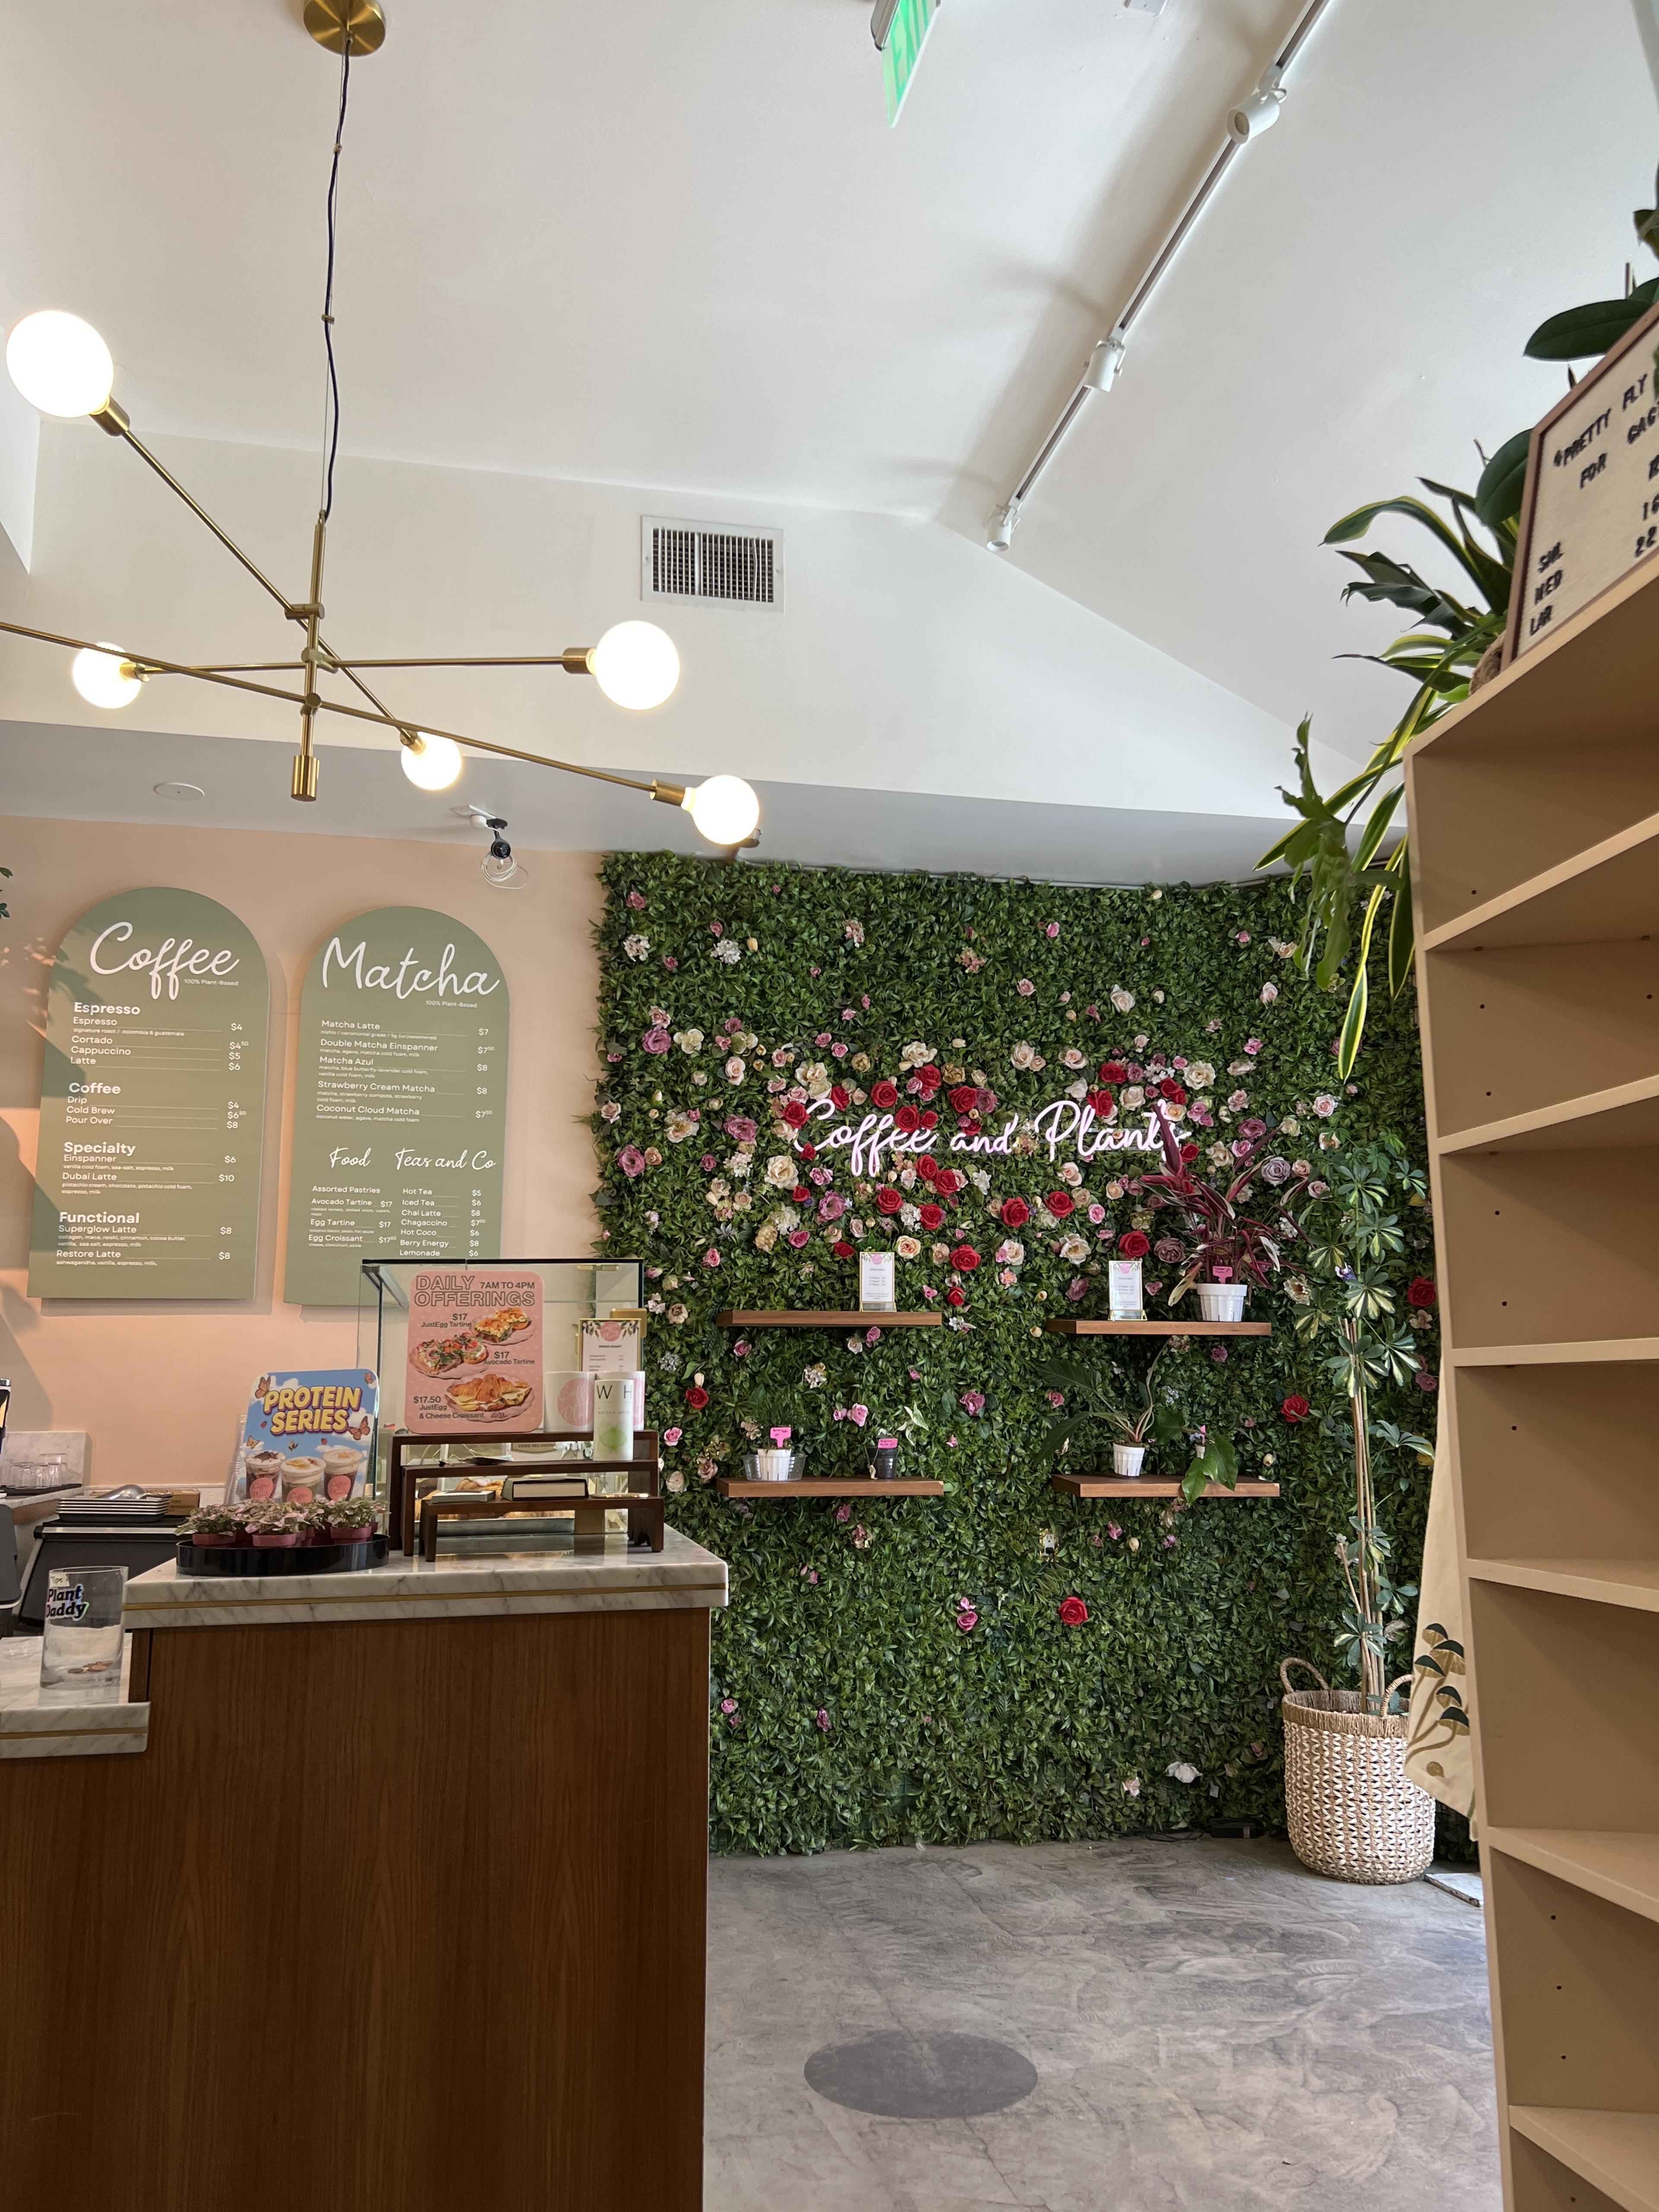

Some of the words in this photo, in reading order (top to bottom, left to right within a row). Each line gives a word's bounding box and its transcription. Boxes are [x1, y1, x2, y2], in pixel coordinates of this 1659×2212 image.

[1622, 373, 1648, 412] FLY
[1579, 452, 1608, 490] FOR
[1535, 569, 1563, 606] MED
[1530, 605, 1553, 636] LAR
[90, 922, 240, 1000] Coffee
[322, 937, 500, 1000] Matcha
[73, 1002, 141, 1015] Espresso
[73, 1017, 118, 1026] Espresso
[231, 1023, 242, 1032] $4
[321, 1020, 355, 1028] Matcha
[478, 1028, 489, 1036] $7
[72, 1035, 113, 1044] Cortado
[321, 1039, 352, 1047] Double
[354, 1041, 387, 1049] Matcha
[390, 1042, 439, 1052] Einspanner
[71, 1046, 131, 1055] Cappuccino
[229, 1052, 240, 1061] $5
[229, 1063, 240, 1071] $6
[477, 1064, 488, 1072] $8
[69, 1083, 121, 1094] Coffee
[318, 1081, 368, 1091] Strawberry
[370, 1083, 400, 1091] Cream
[402, 1084, 435, 1093] Matcha
[477, 1087, 487, 1095] $8
[67, 1096, 87, 1105] Drip
[228, 1101, 239, 1109] $4
[317, 1104, 356, 1113] Coconut
[226, 1121, 238, 1129] $8
[793, 1099, 939, 1177] Coffee
[950, 1113, 1020, 1154] and
[64, 1142, 136, 1156] Specialty
[64, 1154, 117, 1163] Einspanner
[224, 1155, 236, 1164] $6
[330, 1147, 372, 1168] Food
[395, 1147, 432, 1170] Teas
[435, 1150, 468, 1168] and
[471, 1150, 497, 1170] Co
[219, 1174, 235, 1182] $10
[59, 1211, 140, 1224] Functional
[401, 1220, 447, 1228] Chagaccino
[59, 1225, 110, 1234] Superglow
[220, 1227, 232, 1235] $8
[308, 1234, 324, 1243] Egg
[219, 1252, 230, 1260] $8
[416, 1275, 475, 1290] DAILY
[414, 1291, 535, 1307] OFFERINGS
[597, 1385, 613, 1399] W
[263, 1385, 363, 1415] PROTEIN
[413, 1396, 441, 1404] $17.50
[270, 1409, 349, 1435] SERIES
[48, 1586, 82, 1602] Plant
